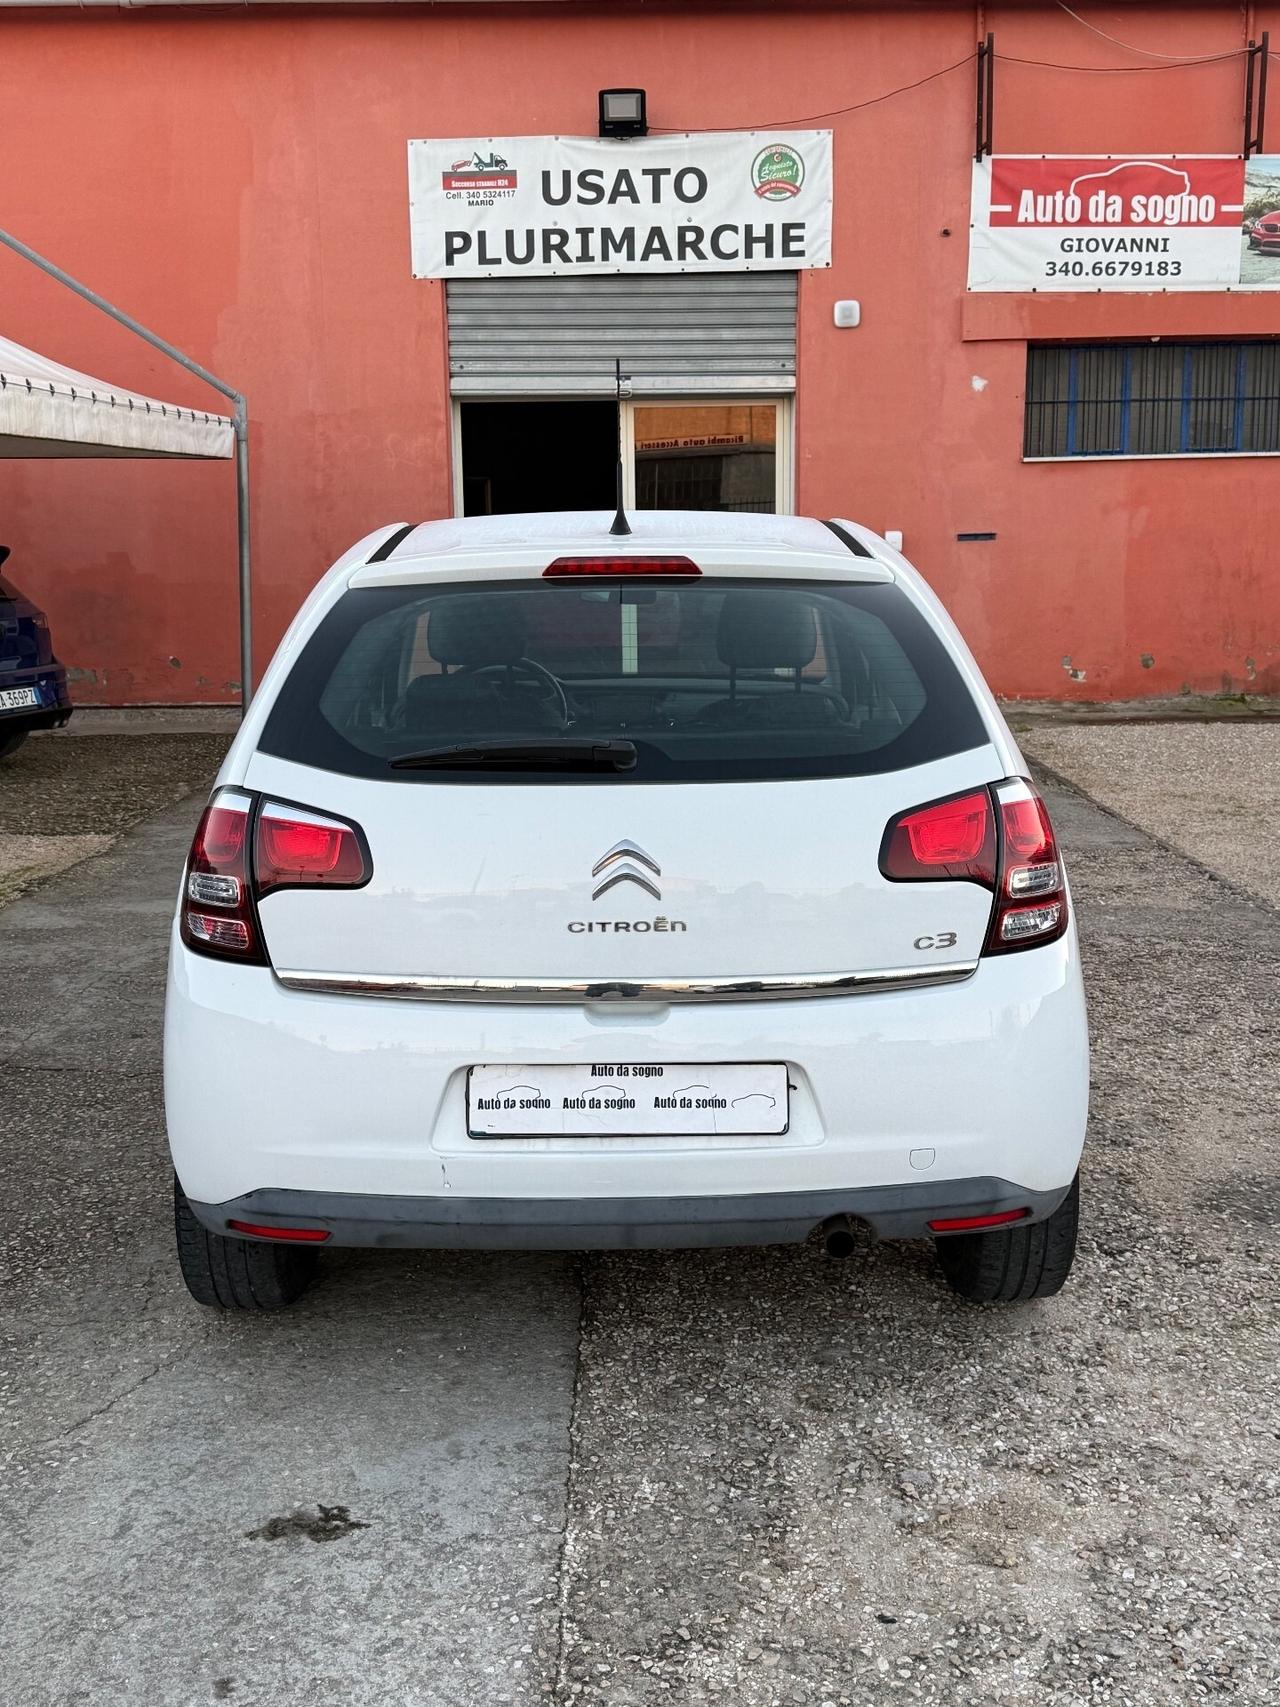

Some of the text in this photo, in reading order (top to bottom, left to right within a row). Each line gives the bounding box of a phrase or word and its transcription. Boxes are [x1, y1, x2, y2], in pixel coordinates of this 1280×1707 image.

[541, 167, 708, 206] USATO
[445, 190, 516, 200] Cell. 340 5324117
[467, 199, 494, 207] MARIO
[1017, 189, 1216, 226] Auto da sogno
[444, 222, 806, 267] PLURIMARCHE
[1060, 237, 1170, 253] GIOVANNI
[1045, 261, 1182, 277] 340.6679183
[7, 689, 36, 706] 369PZ
[913, 932, 957, 950] C3
[590, 1065, 664, 1078] Auto da sogno
[477, 1098, 501, 1110] Auto
[503, 1098, 516, 1109] da
[562, 1098, 636, 1110] Auto da sogno
[653, 1096, 677, 1109] Auto
[679, 1097, 693, 1109] da
